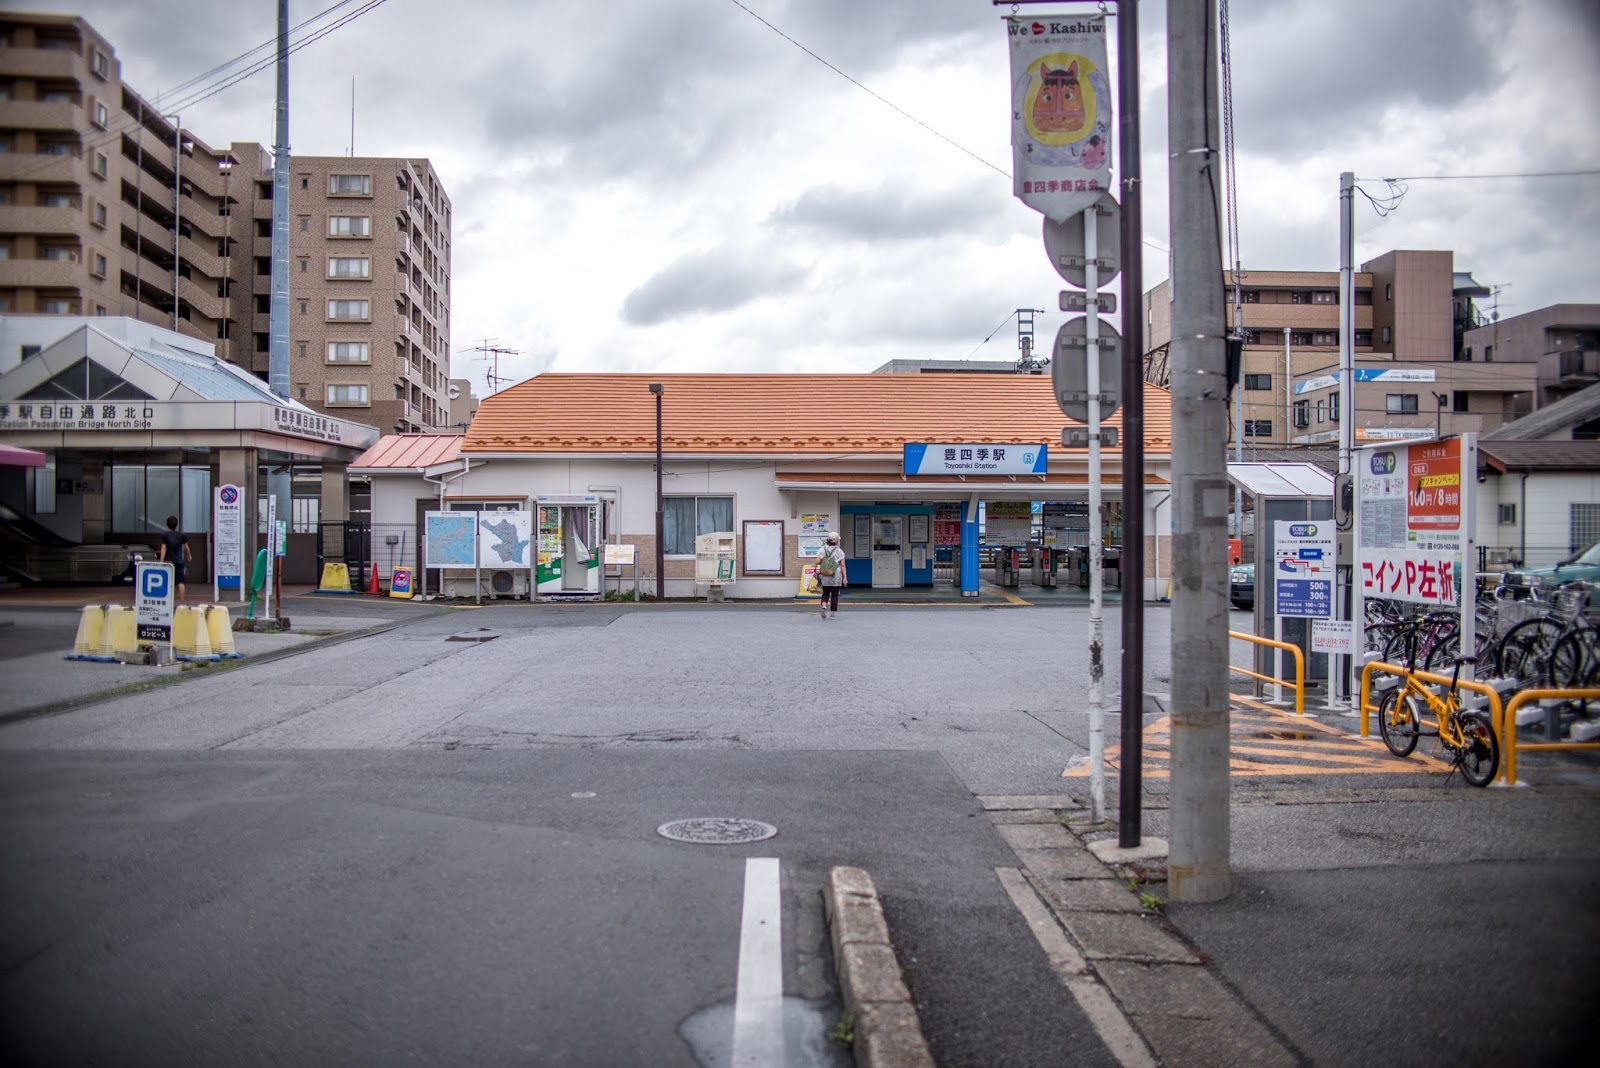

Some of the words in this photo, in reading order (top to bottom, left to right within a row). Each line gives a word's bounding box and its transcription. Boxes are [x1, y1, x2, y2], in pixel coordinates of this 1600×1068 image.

[1008, 24, 1028, 36] We
[1023, 178, 1099, 194] 豊四季商店会
[31, 420, 75, 430] Pedestrian
[78, 420, 105, 430] Bridge
[107, 420, 131, 430] North
[134, 420, 151, 430] Side
[944, 448, 1005, 461] 豊四季駅
[1422, 448, 1446, 459] ご利用料金
[1372, 456, 1386, 466] TOBU
[1413, 465, 1426, 474] 自転車
[147, 573, 163, 593] P
[1362, 559, 1453, 602] コインP左折
